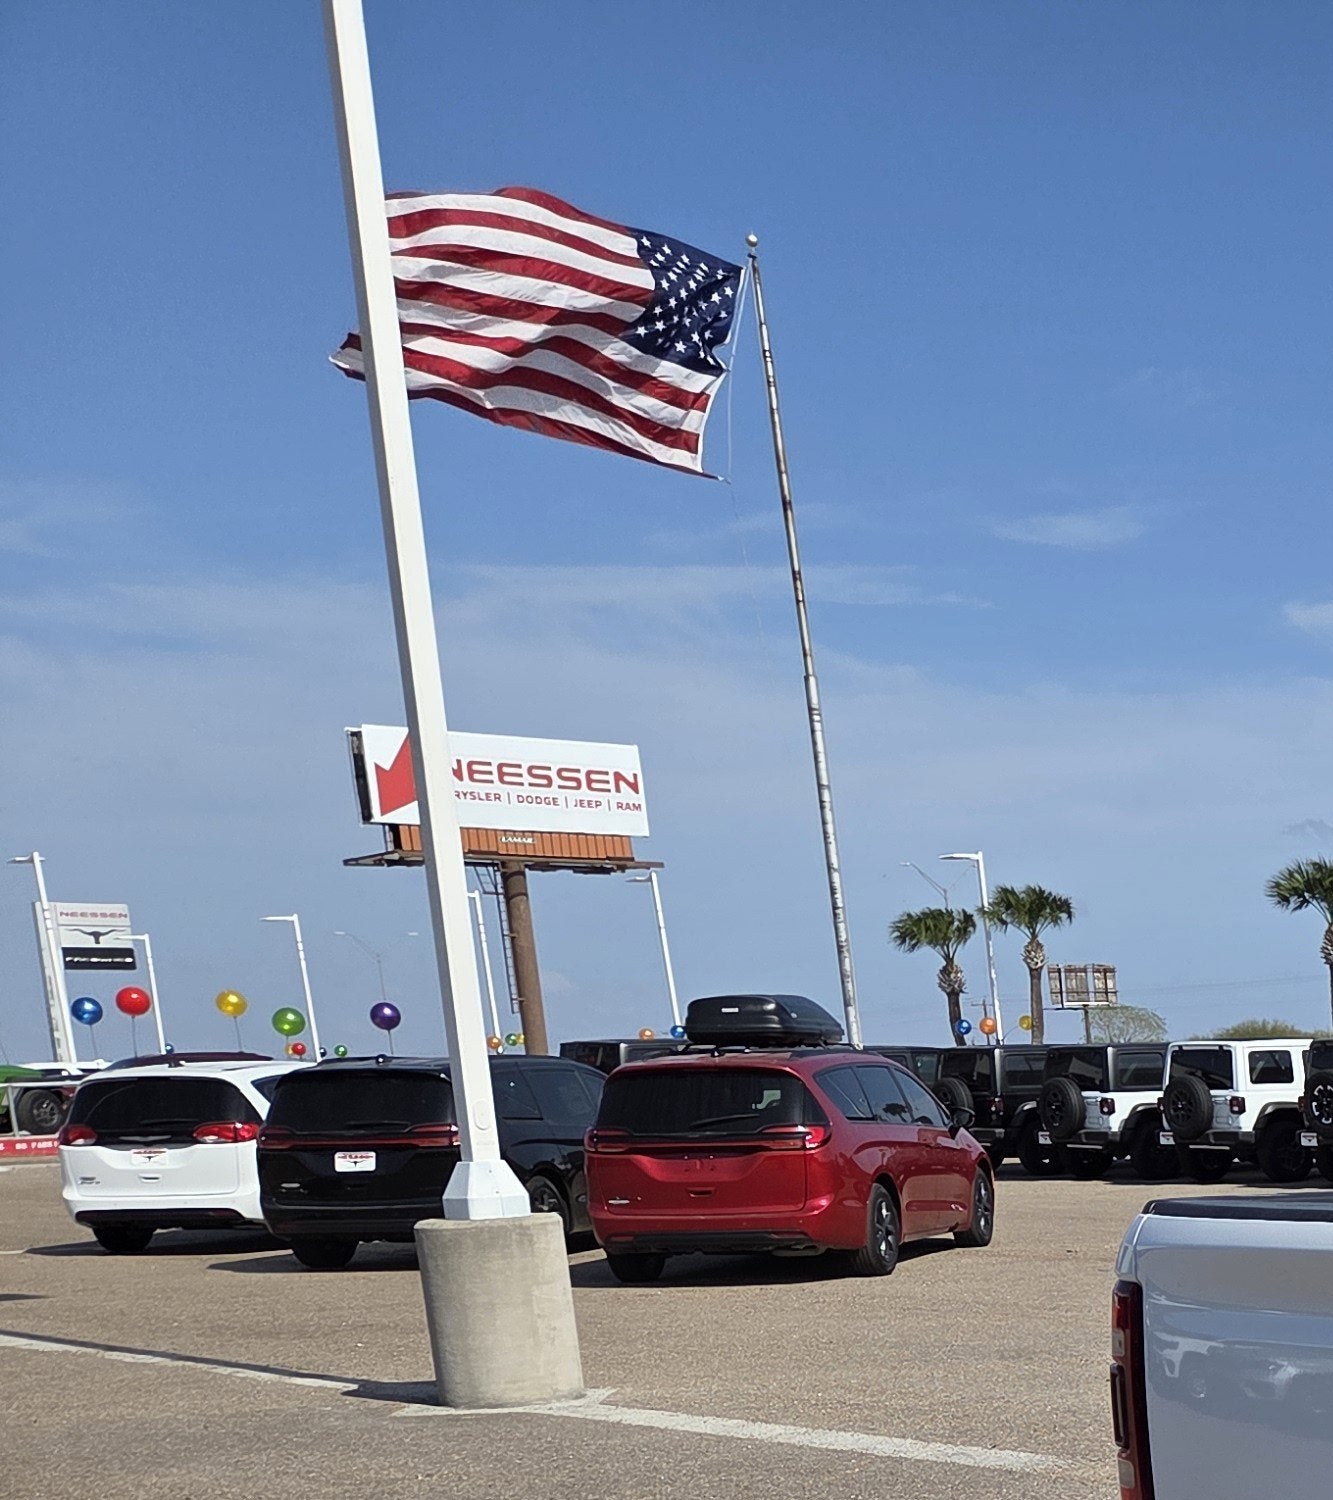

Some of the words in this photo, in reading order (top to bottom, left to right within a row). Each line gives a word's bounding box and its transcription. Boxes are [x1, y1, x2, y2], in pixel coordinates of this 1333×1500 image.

[516, 794, 560, 807] DODGE
[573, 798, 602, 809] JEEP
[616, 801, 642, 812] RAM
